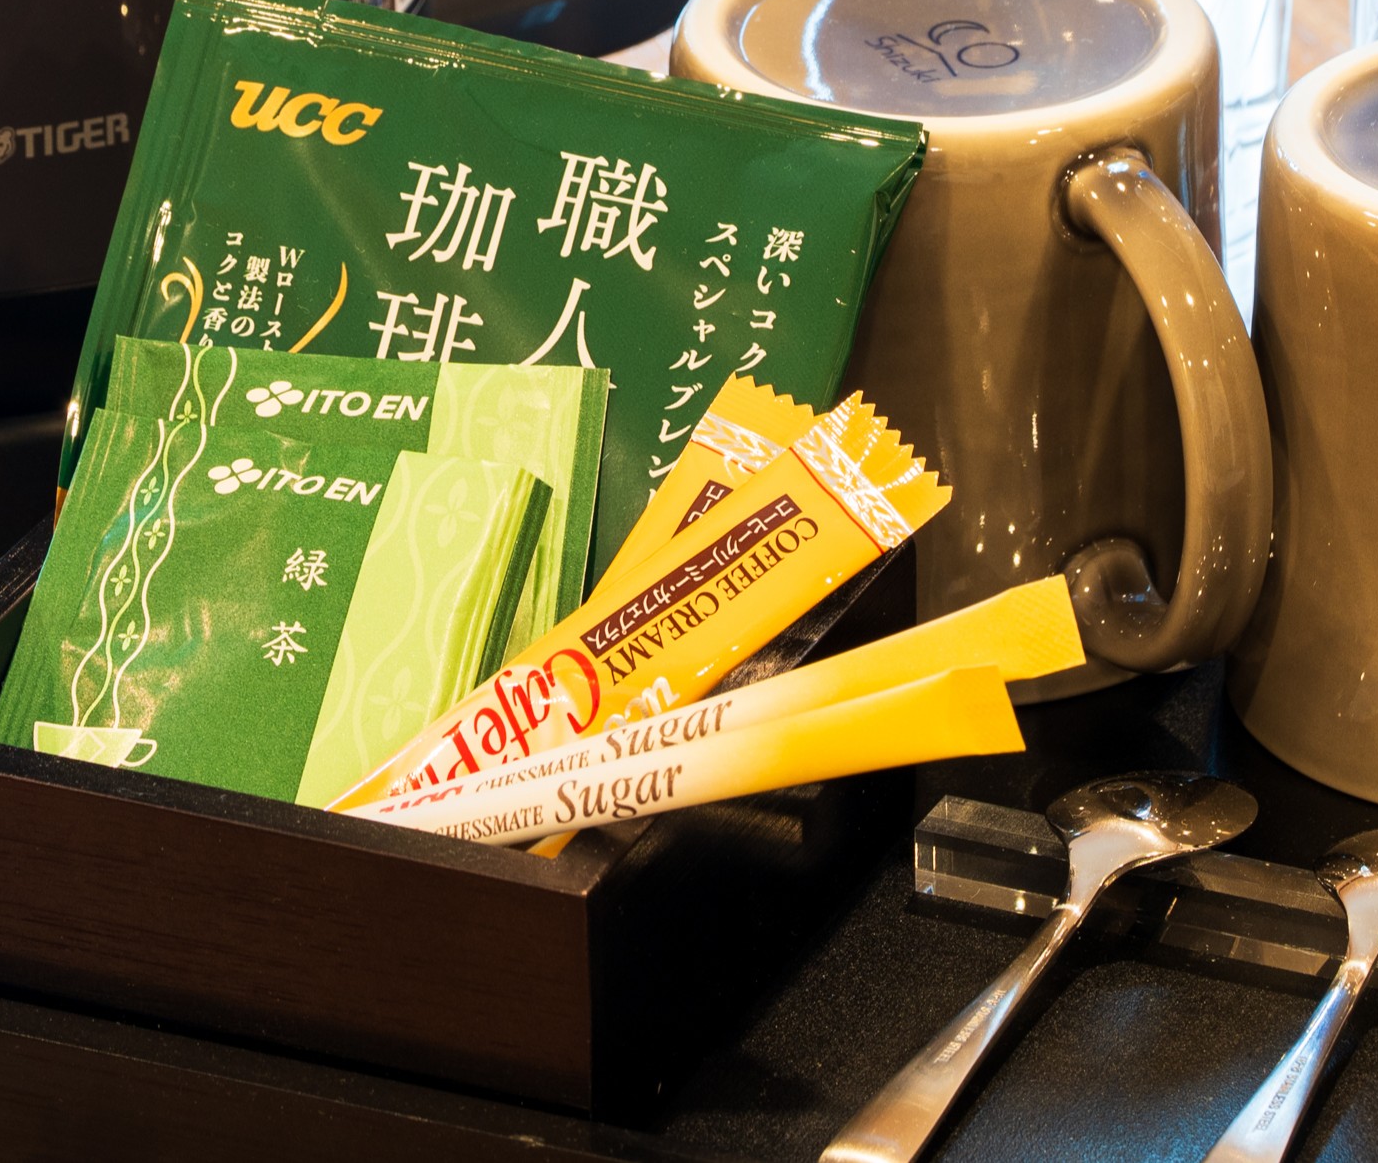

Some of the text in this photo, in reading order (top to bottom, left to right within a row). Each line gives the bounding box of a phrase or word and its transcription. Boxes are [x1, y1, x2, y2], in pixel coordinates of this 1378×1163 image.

[16, 112, 131, 159] TIGER
[231, 255, 271, 337] 製法の
[368, 161, 517, 364] 珈琲
[518, 151, 669, 388] 職人
[734, 226, 805, 373] 深いコク
[301, 389, 429, 421] ITO EN
[648, 221, 739, 507] スペシャルブレン
[256, 468, 382, 506] ITO EN
[260, 547, 330, 668] 緑茶
[601, 516, 820, 687] COFFEE CREAMY
[601, 699, 733, 764] Sugar
[554, 764, 683, 824] Sugar
